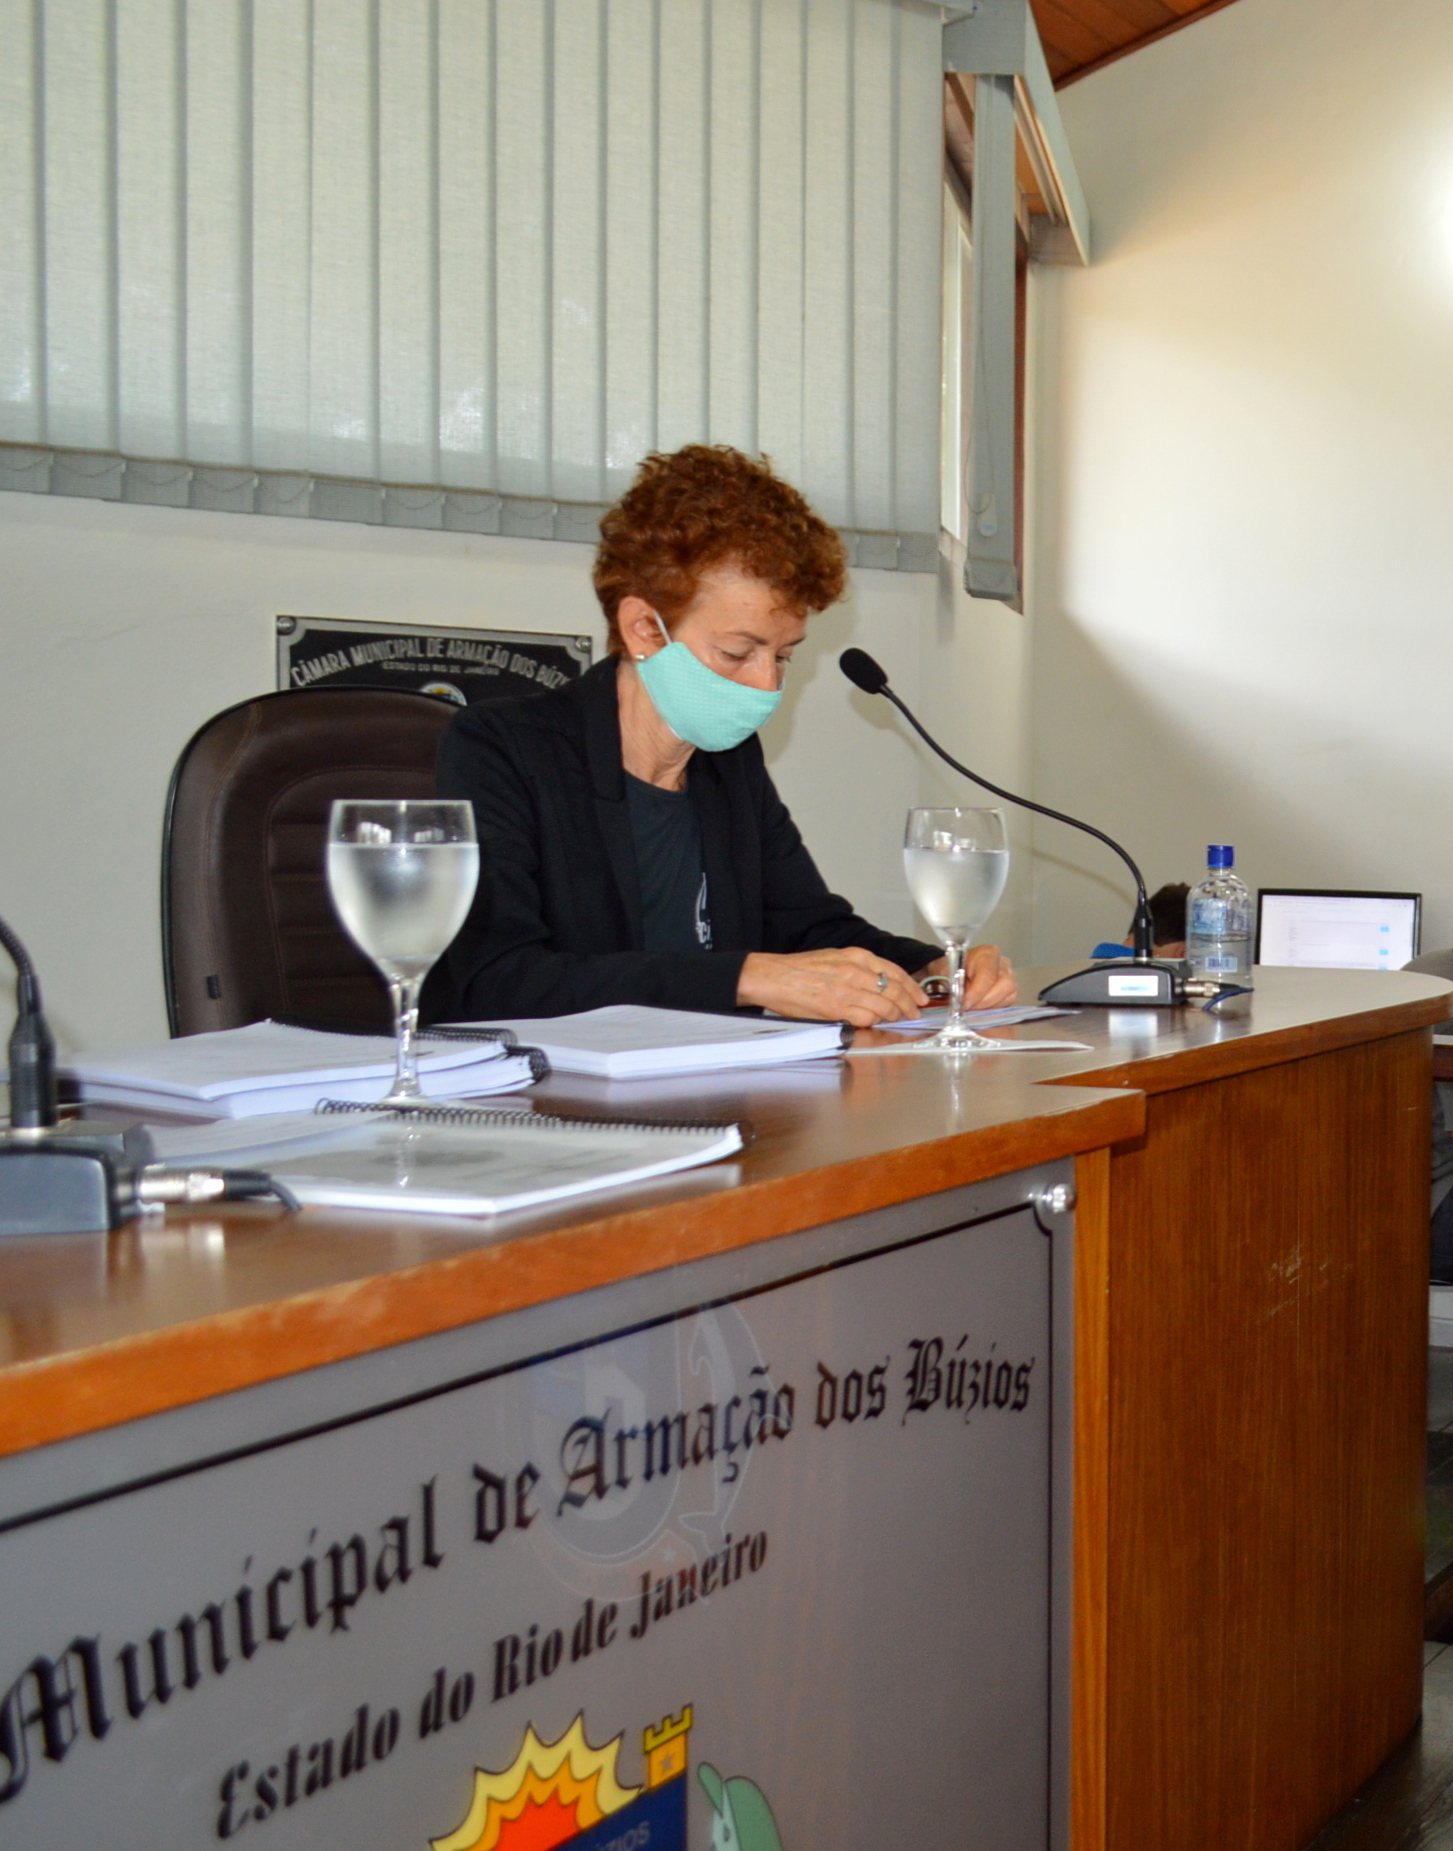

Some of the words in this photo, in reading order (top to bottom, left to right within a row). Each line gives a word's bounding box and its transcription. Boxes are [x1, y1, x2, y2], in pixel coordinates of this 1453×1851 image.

[291, 650, 351, 687] CÂMARA
[350, 638, 424, 667] MUNICIPAL
[426, 638, 445, 658] DE
[446, 640, 510, 669] ARMAÇÃO
[509, 653, 538, 679] DOS
[0, 1474, 446, 1801] Municipal
[471, 1460, 541, 1544] de
[557, 1364, 796, 1517] Armação
[814, 1355, 891, 1429] dos
[901, 1333, 1036, 1426] Búzios
[216, 1703, 400, 1840] Estado
[418, 1666, 475, 1740] do
[491, 1622, 565, 1703] Rio
[570, 1597, 618, 1663] de
[629, 1530, 768, 1640] Janeiro
